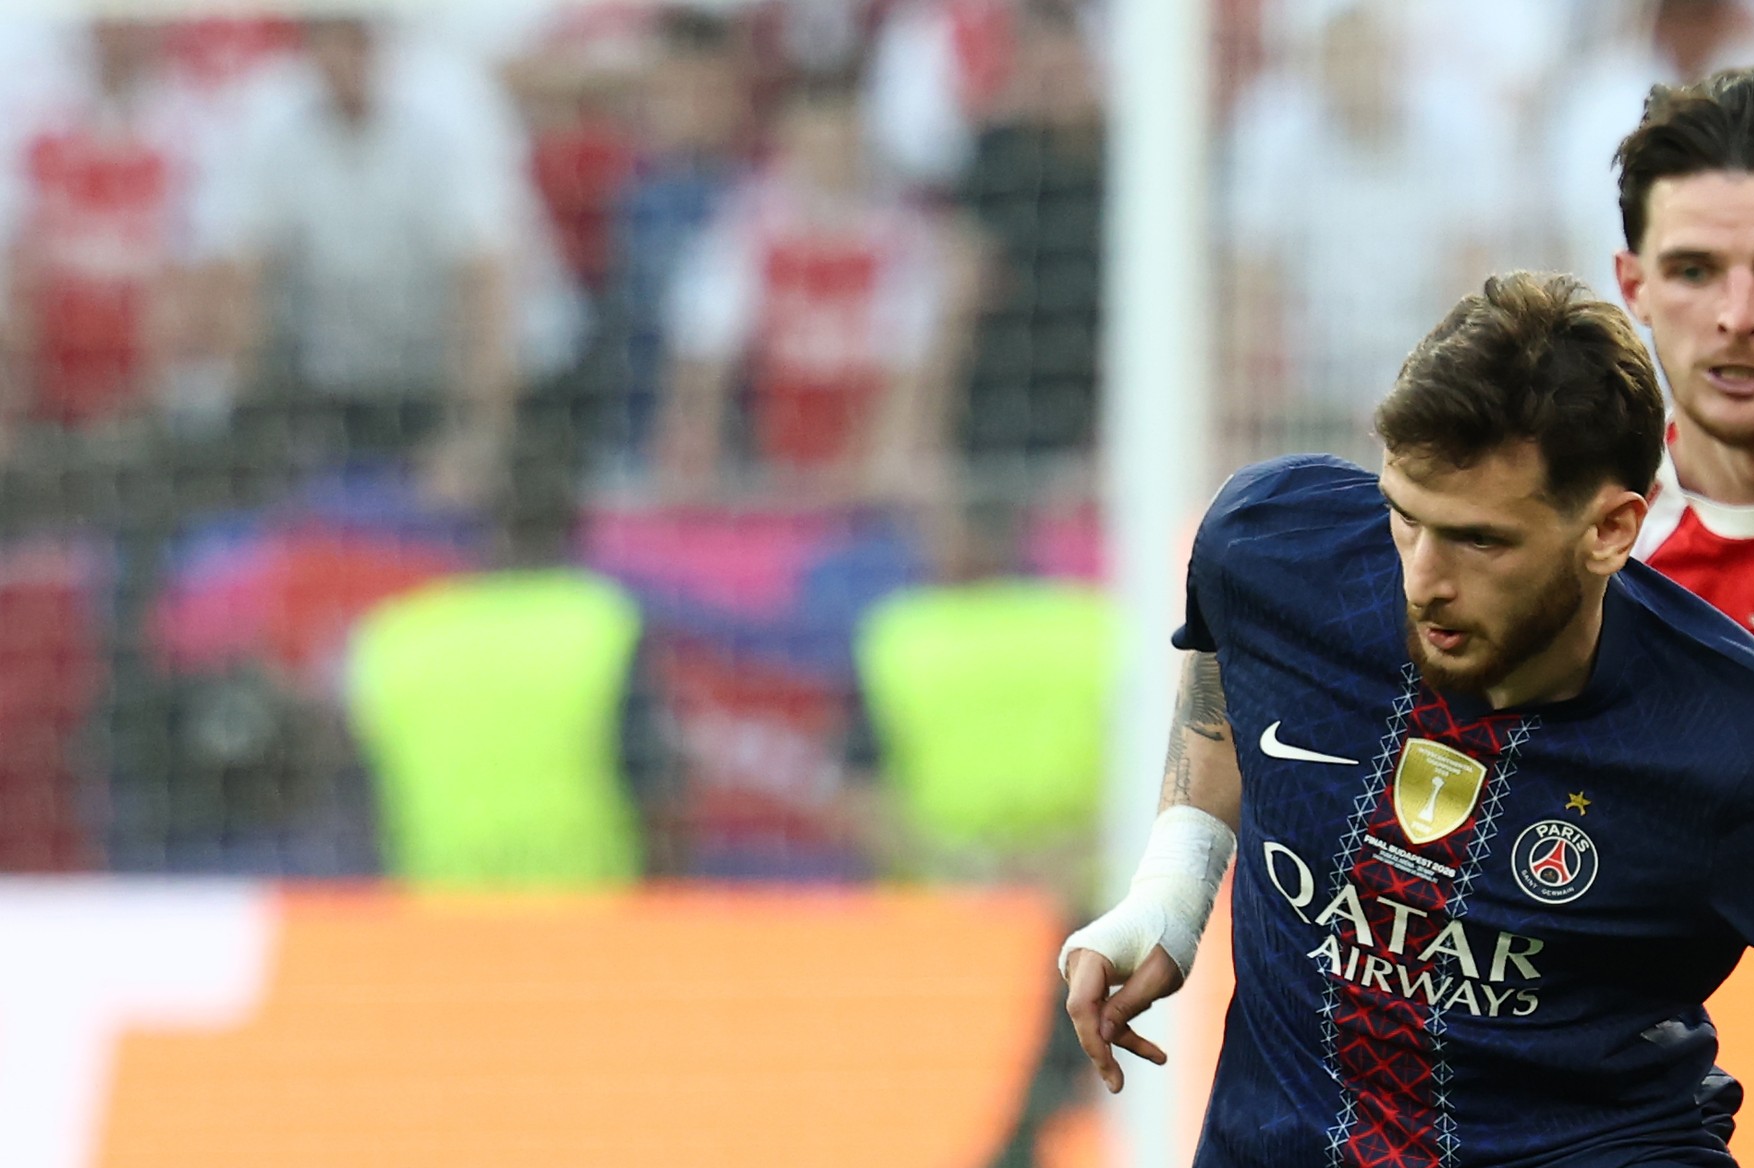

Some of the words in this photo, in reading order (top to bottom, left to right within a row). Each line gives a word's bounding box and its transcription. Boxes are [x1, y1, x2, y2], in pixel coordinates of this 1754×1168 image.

[1363, 834, 1389, 851] FINAL
[1388, 844, 1434, 868] BUDAPEST
[1432, 862, 1457, 878] 2026
[1535, 824, 1590, 852] PARIS
[1521, 869, 1538, 889] SAINT
[1541, 886, 1575, 897] GERMAIN
[1263, 841, 1544, 982] QATAR
[1306, 934, 1540, 1017] AIRWAYS
